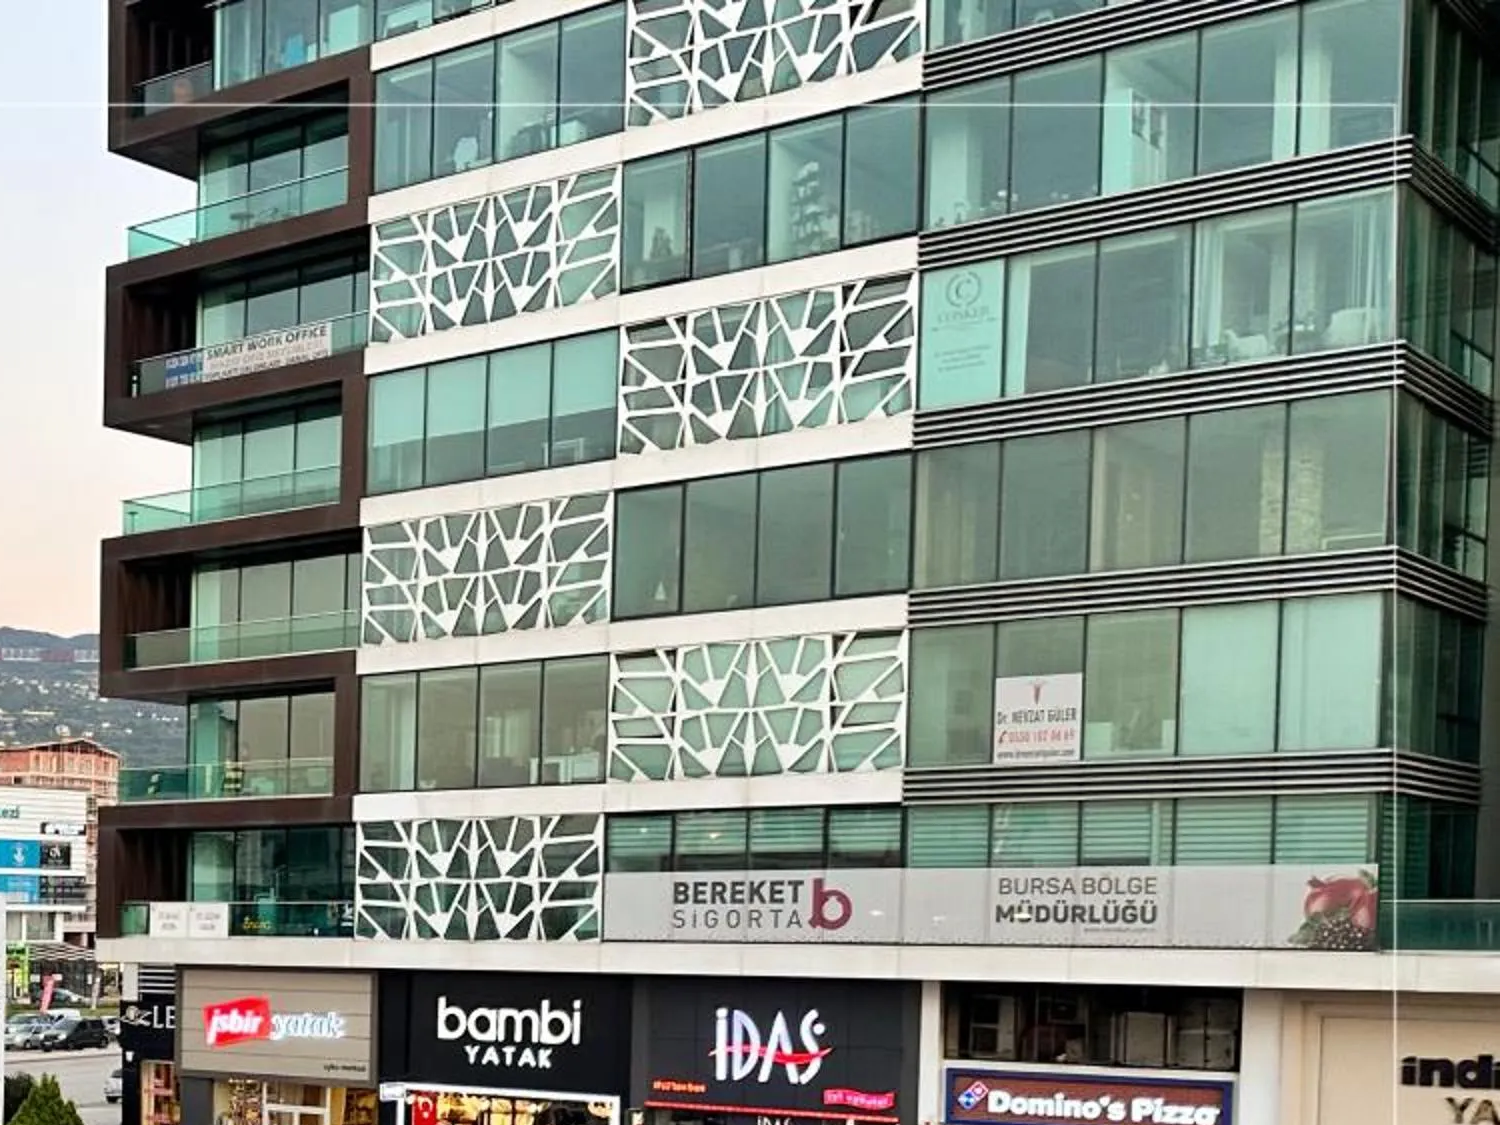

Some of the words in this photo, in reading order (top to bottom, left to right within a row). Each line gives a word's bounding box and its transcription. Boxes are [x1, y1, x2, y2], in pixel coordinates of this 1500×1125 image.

[206, 342, 244, 361] SMART
[247, 333, 283, 352] WORK
[285, 325, 328, 344] OFFICE
[673, 880, 804, 905] BEREKET
[998, 876, 1077, 896] BURSA
[995, 899, 1158, 924] MÜDÜRLÜĞÜ
[436, 995, 582, 1046] bambi
[464, 1045, 553, 1069] YATAK
[987, 1089, 1127, 1123] Domino's
